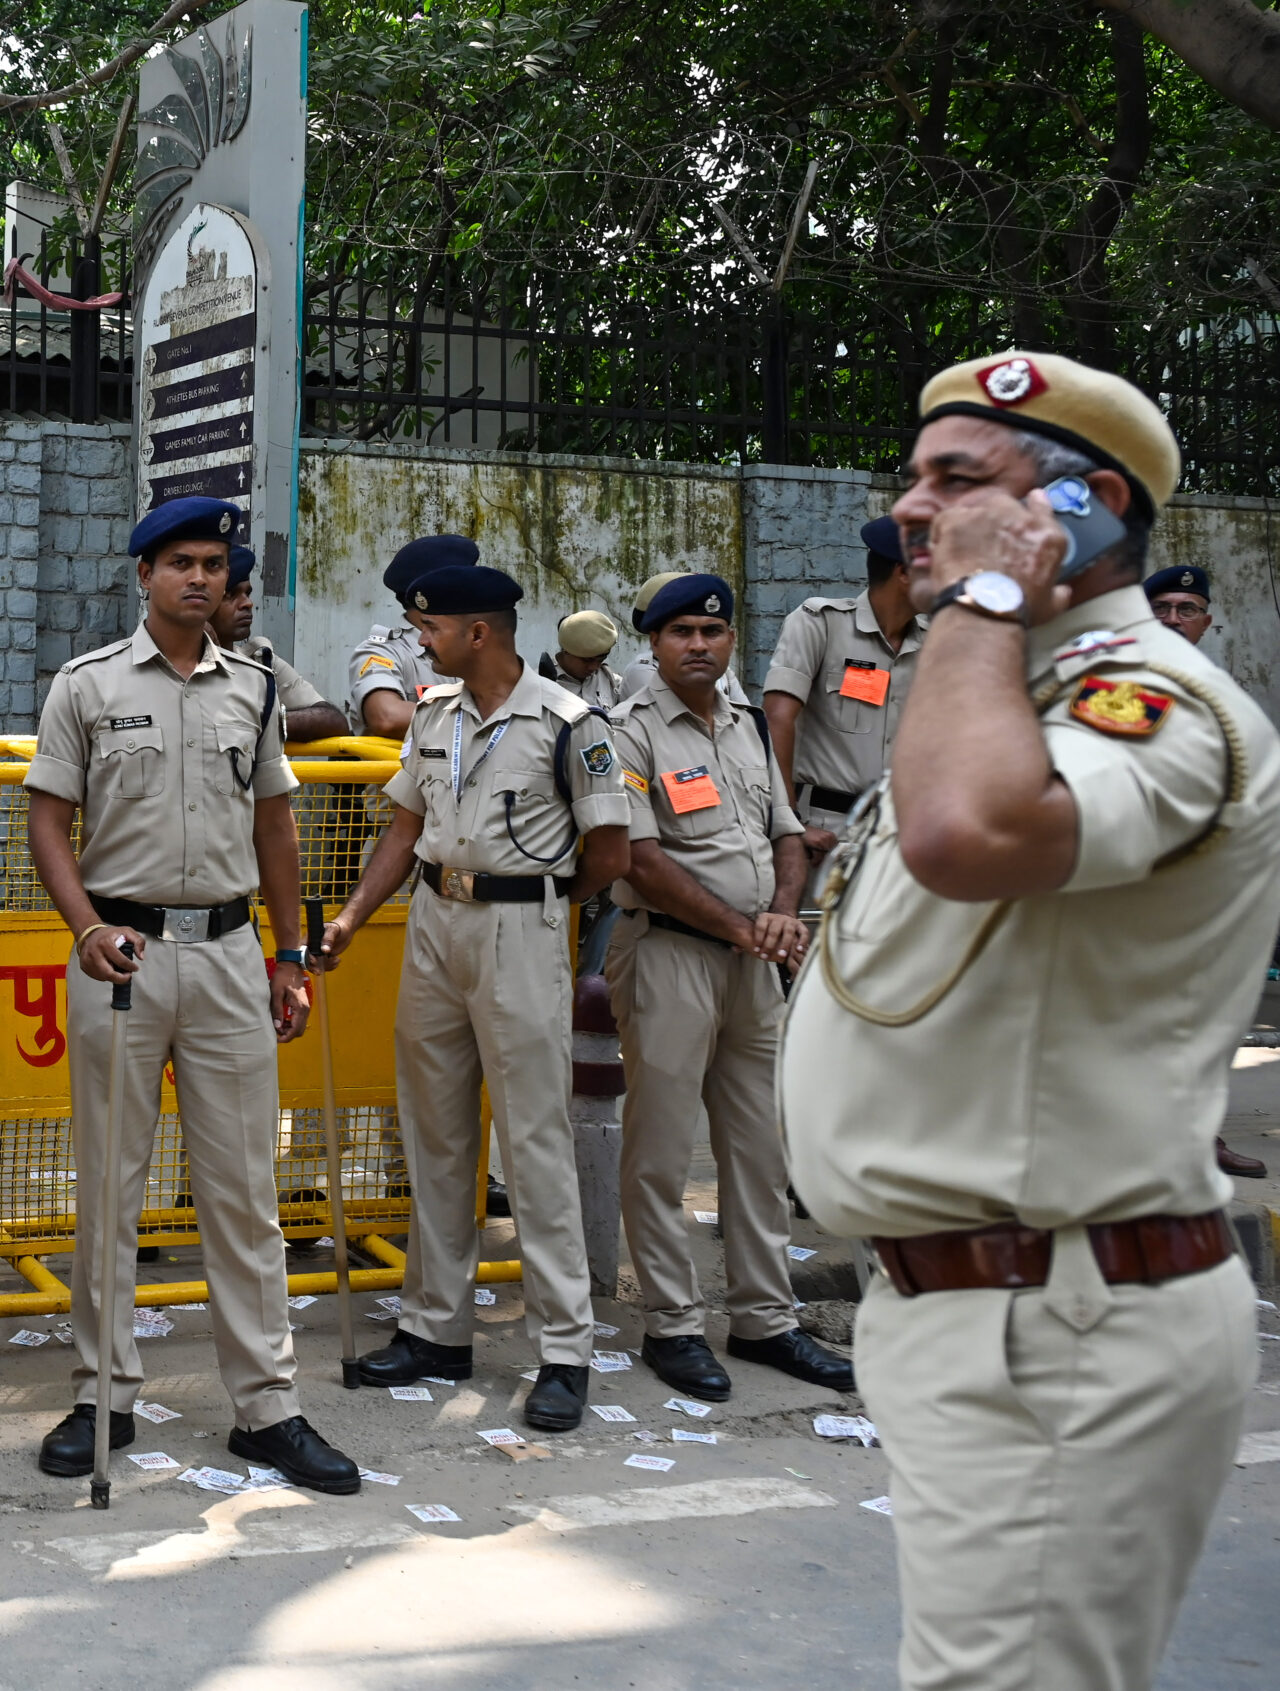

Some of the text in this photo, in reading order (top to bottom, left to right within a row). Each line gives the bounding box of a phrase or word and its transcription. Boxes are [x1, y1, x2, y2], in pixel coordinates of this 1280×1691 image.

[188, 294, 222, 317] COMPETITION
[223, 289, 242, 304] VENUE
[167, 348, 181, 360] GATE
[166, 384, 220, 405] ATHLETES BUS PARKING
[165, 428, 230, 450] GAMES FAMILY CAR PARKING
[163, 480, 204, 496] DRIVERS LOUNGE
[486, 742, 496, 751] FOR
[491, 725, 504, 742] POLICE
